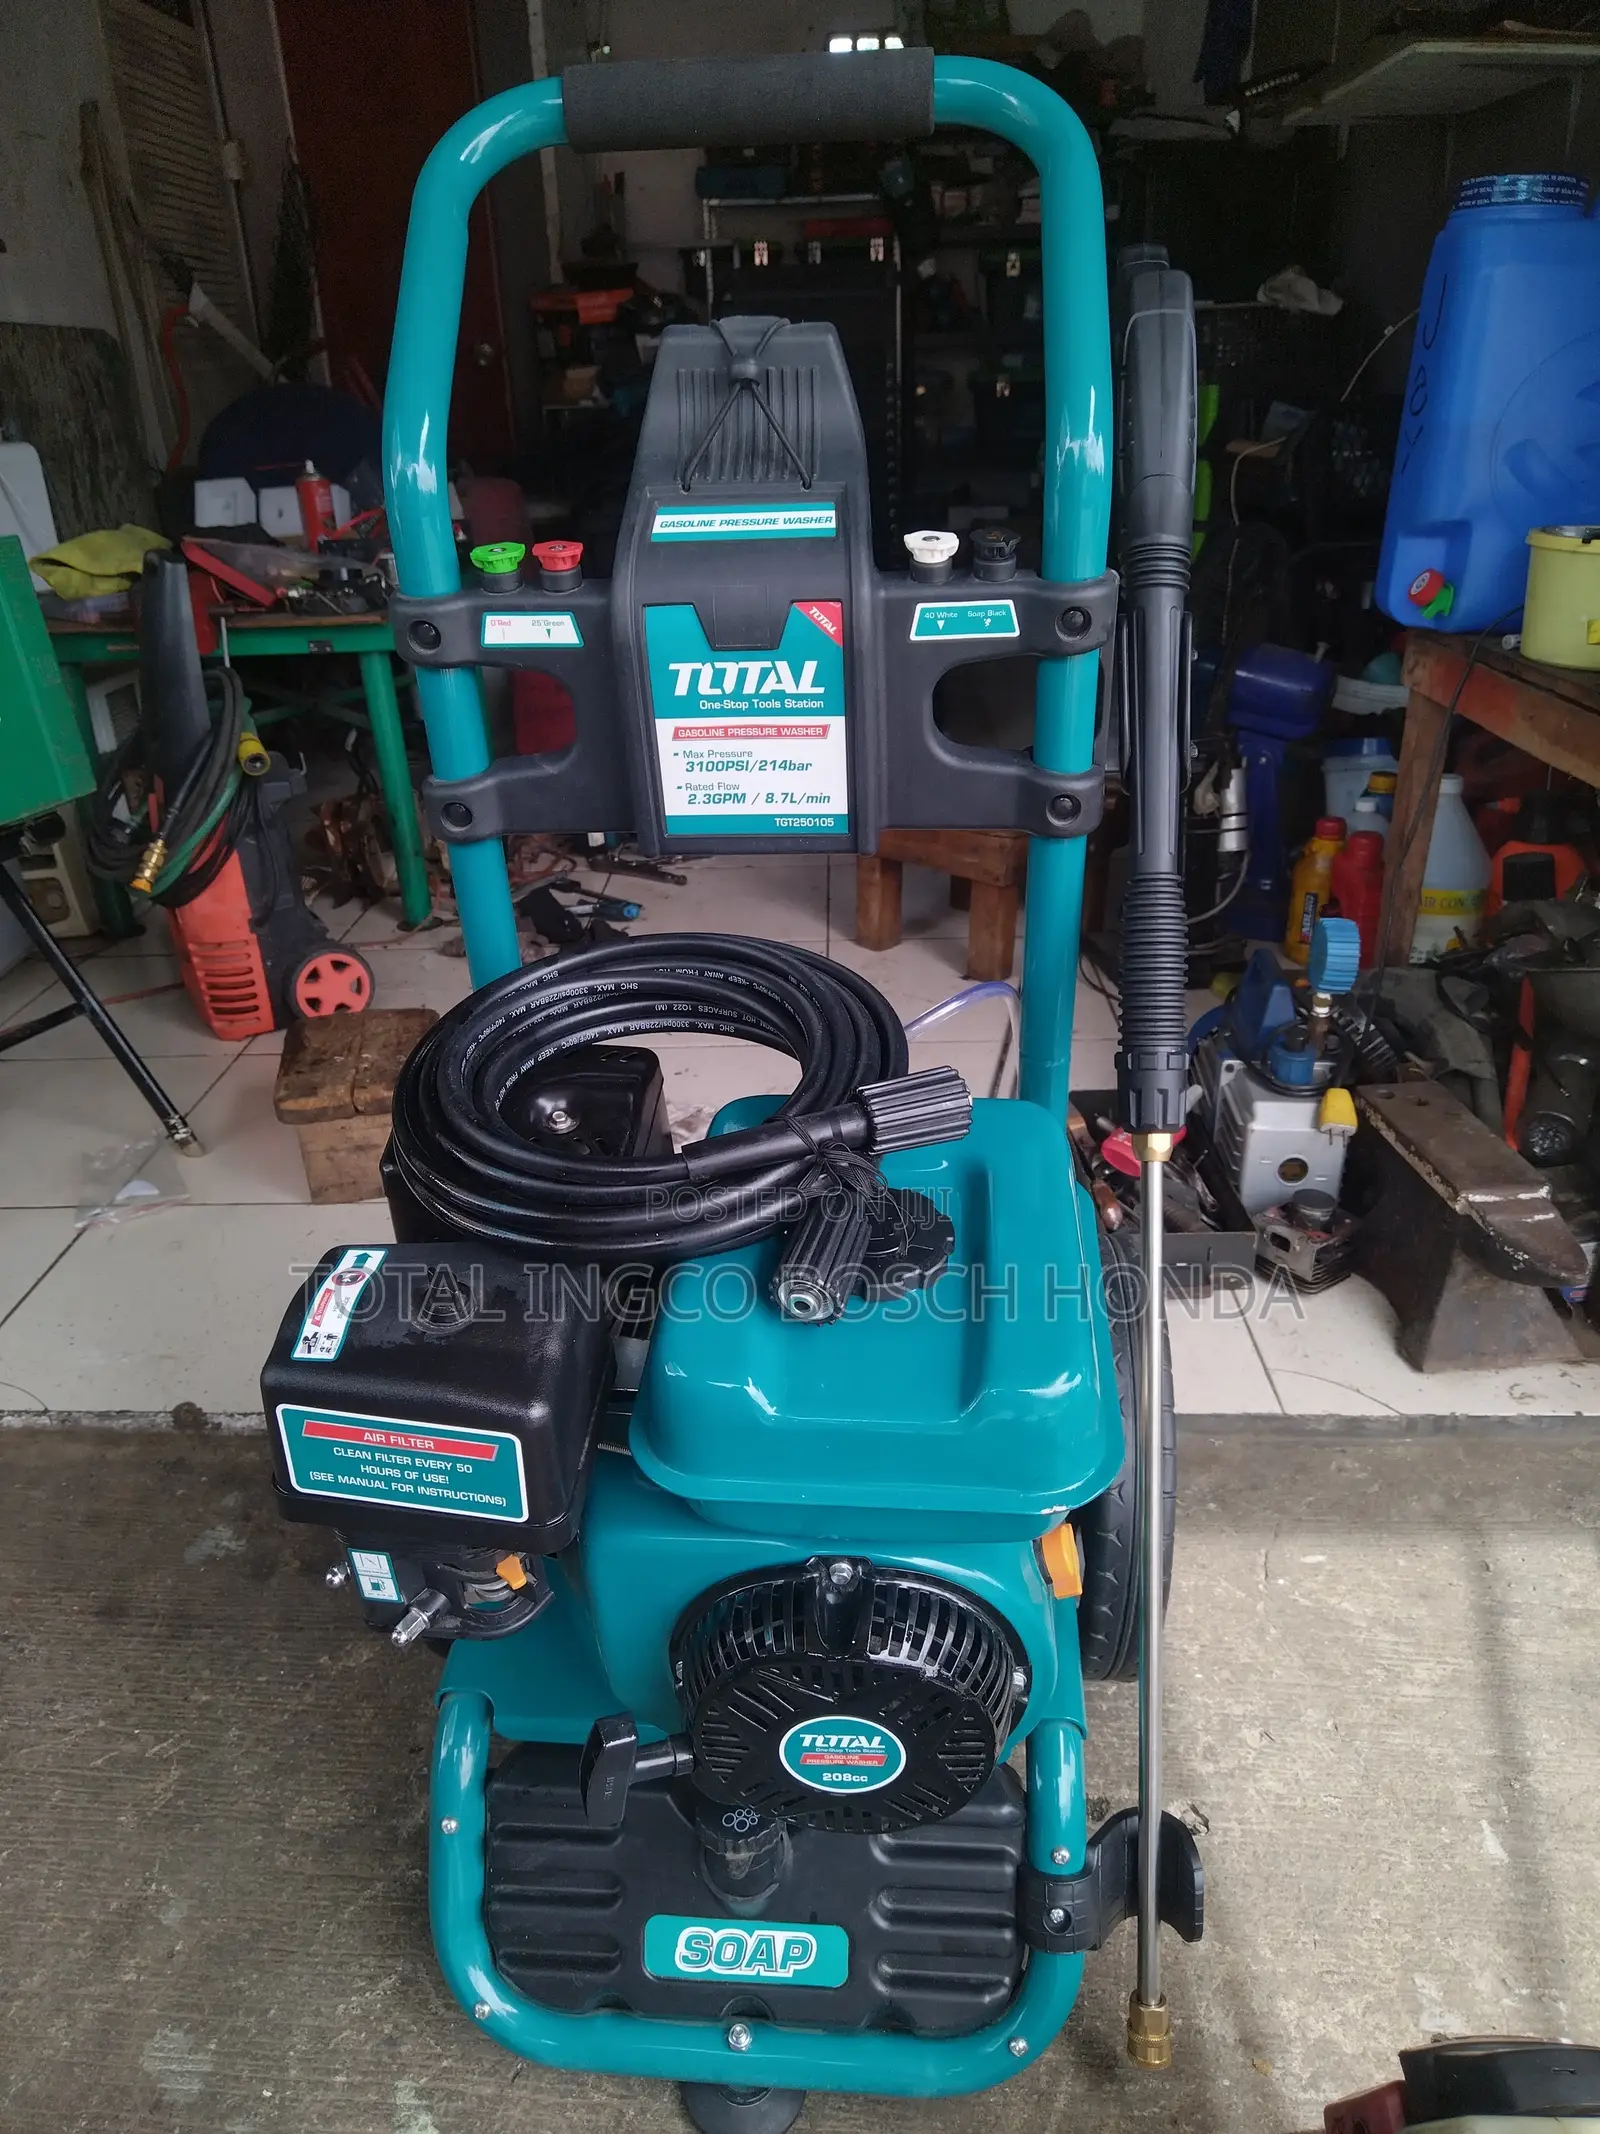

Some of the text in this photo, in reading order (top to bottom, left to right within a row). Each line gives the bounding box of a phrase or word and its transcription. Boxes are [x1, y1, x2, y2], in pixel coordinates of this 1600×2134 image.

[660, 516, 833, 529] GASOLINE PRESSURE WASHER
[808, 606, 838, 635] TOTAL
[936, 611, 958, 619] White
[967, 610, 985, 618] Soap
[987, 609, 1007, 617] Black
[668, 660, 826, 696] TOTAL
[699, 698, 824, 711] One-Stop Tools Station
[678, 727, 823, 738] GASOLINE PRESSURE WASHER
[683, 749, 753, 758] Max Pressure
[685, 759, 813, 773] 3100PSI/214bar
[685, 782, 740, 791] Rated Flow
[687, 792, 831, 805] 2.3GPM / 8.7L/min
[774, 817, 835, 827] TGT250105
[593, 983, 615, 992] MAX.
[620, 982, 639, 990] SHC
[508, 1005, 527, 1018] MAX.
[655, 1003, 668, 1012] (M)
[697, 1005, 738, 1018] SURFACES
[695, 1021, 715, 1030] MAX.
[719, 1024, 735, 1033] SHC
[363, 1432, 435, 1450] AIR FILTER
[333, 1447, 473, 1474] CLEAN FILTER EVERY 50
[360, 1464, 450, 1485] HOURS OF USE!
[309, 1471, 507, 1507] (SEE MANUAL FOR INSTRUCTIONS)
[799, 1733, 886, 1749] TOTAL
[822, 1772, 869, 1783] 208cc
[676, 1928, 815, 1975] SOAP
